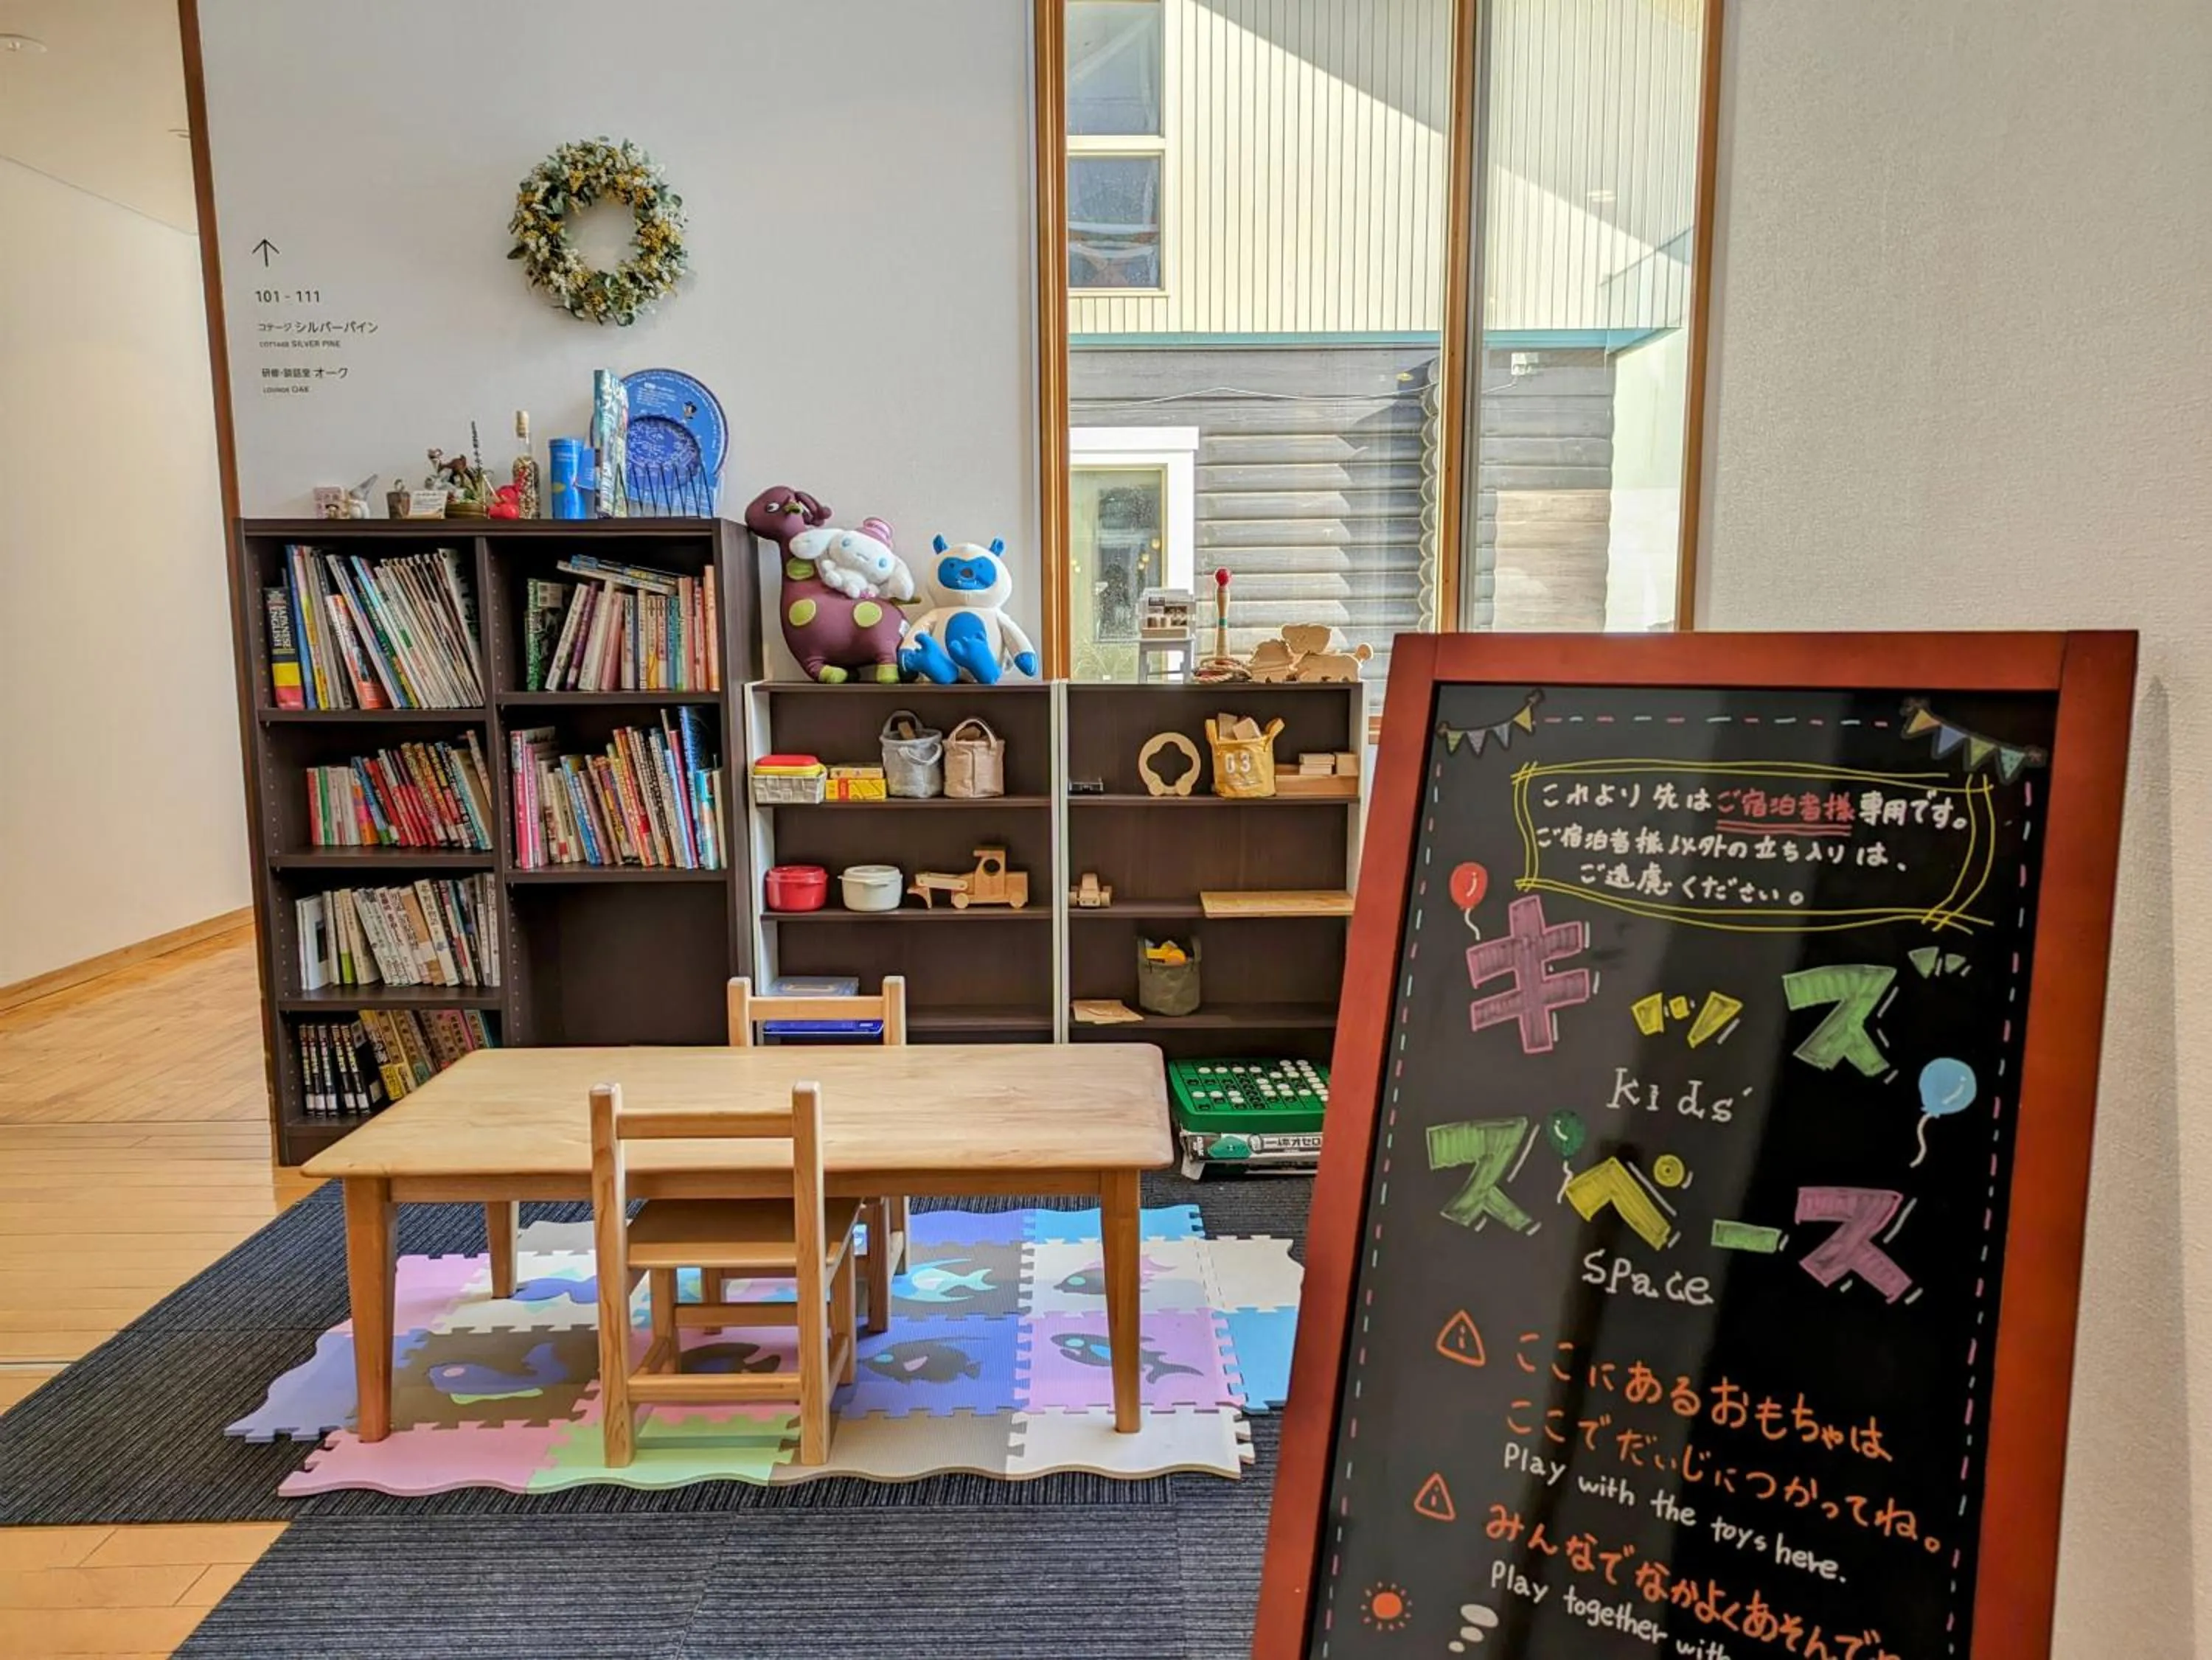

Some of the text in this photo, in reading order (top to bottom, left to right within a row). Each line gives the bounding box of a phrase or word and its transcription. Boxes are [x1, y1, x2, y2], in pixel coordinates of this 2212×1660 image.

[255, 290, 279, 303] 101
[296, 290, 320, 303] 111
[296, 321, 378, 332] シルバーパイン
[291, 386, 309, 394] OAK
[313, 367, 348, 379] オーク
[1466, 895, 1966, 1077] キッズ
[1426, 1116, 1914, 1303] スペース
[1517, 1333, 1893, 1462] ここにあるおもちゃは
[1504, 1443, 1846, 1583] Play with the toys here.
[1491, 1560, 1548, 1603] Play
[1563, 1585, 1669, 1645] together
